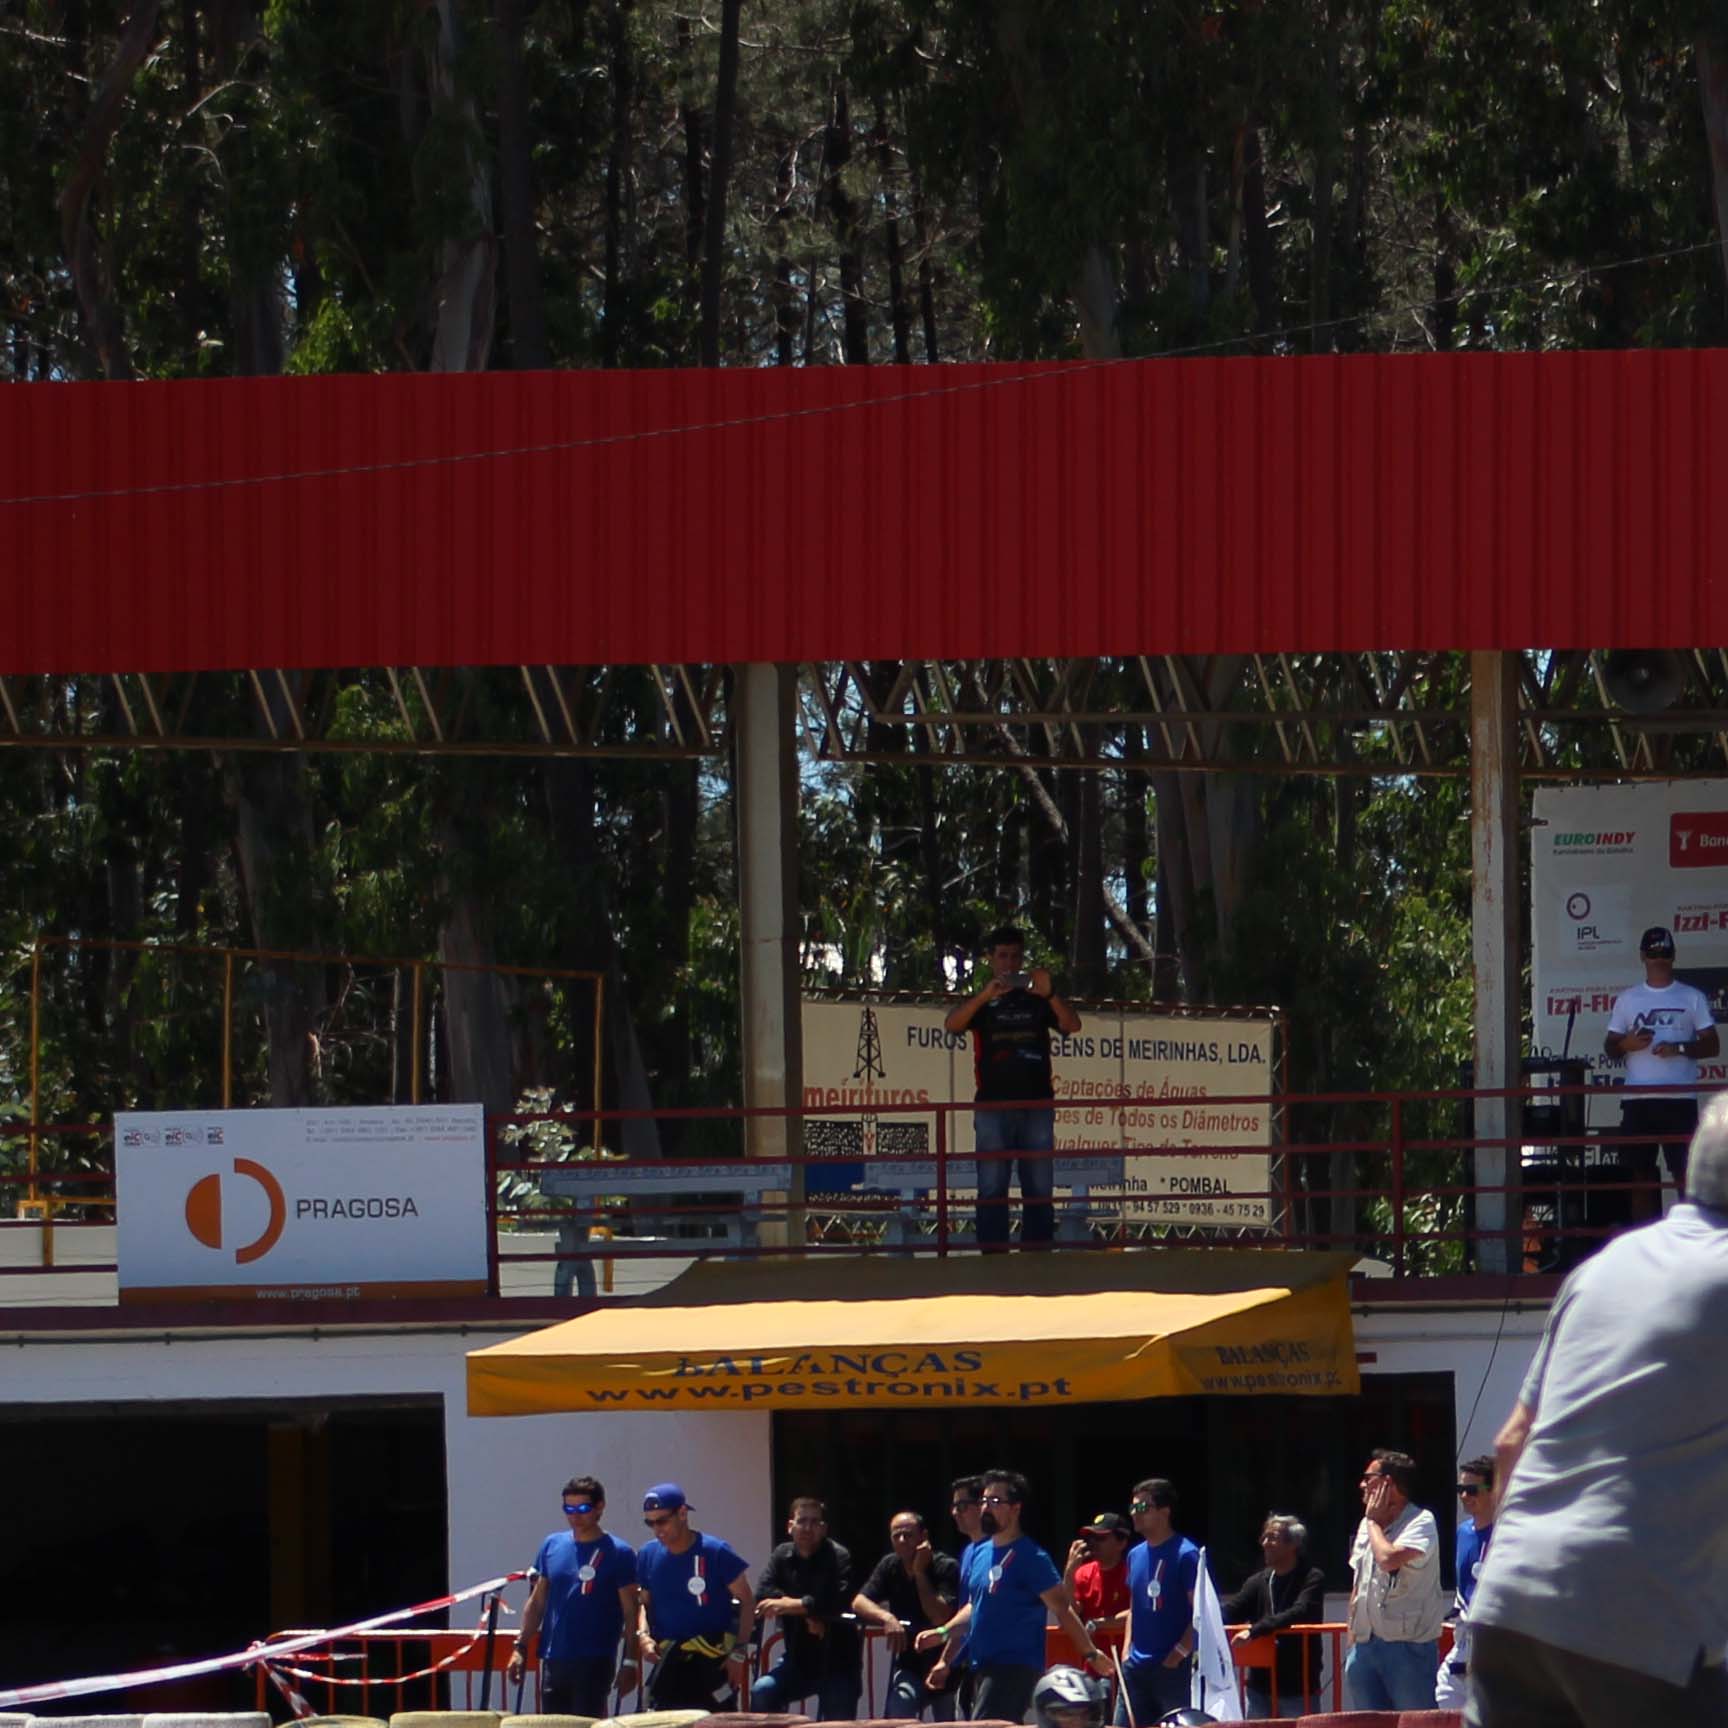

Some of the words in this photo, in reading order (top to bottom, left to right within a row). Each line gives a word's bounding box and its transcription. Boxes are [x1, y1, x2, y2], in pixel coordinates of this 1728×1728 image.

[1553, 832, 1636, 846] EUROINDY
[908, 1026, 967, 1050] FUROS
[1050, 1036, 1096, 1058] GENS
[1101, 1038, 1123, 1059] DE
[1129, 1039, 1223, 1064] MEIRINHAS,
[1227, 1042, 1267, 1065] LDA.
[1136, 1081, 1155, 1098] de
[1085, 1107, 1104, 1124] de
[1110, 1107, 1155, 1129] Todos
[1160, 1115, 1178, 1129] os
[1182, 1109, 1260, 1132] Diâmetros
[1170, 1177, 1231, 1195] POMBAL
[296, 1197, 419, 1220] PRAGOSA
[255, 1286, 361, 1300] www.pragosa.pt
[588, 1376, 1073, 1403] www.pestronix.pt
